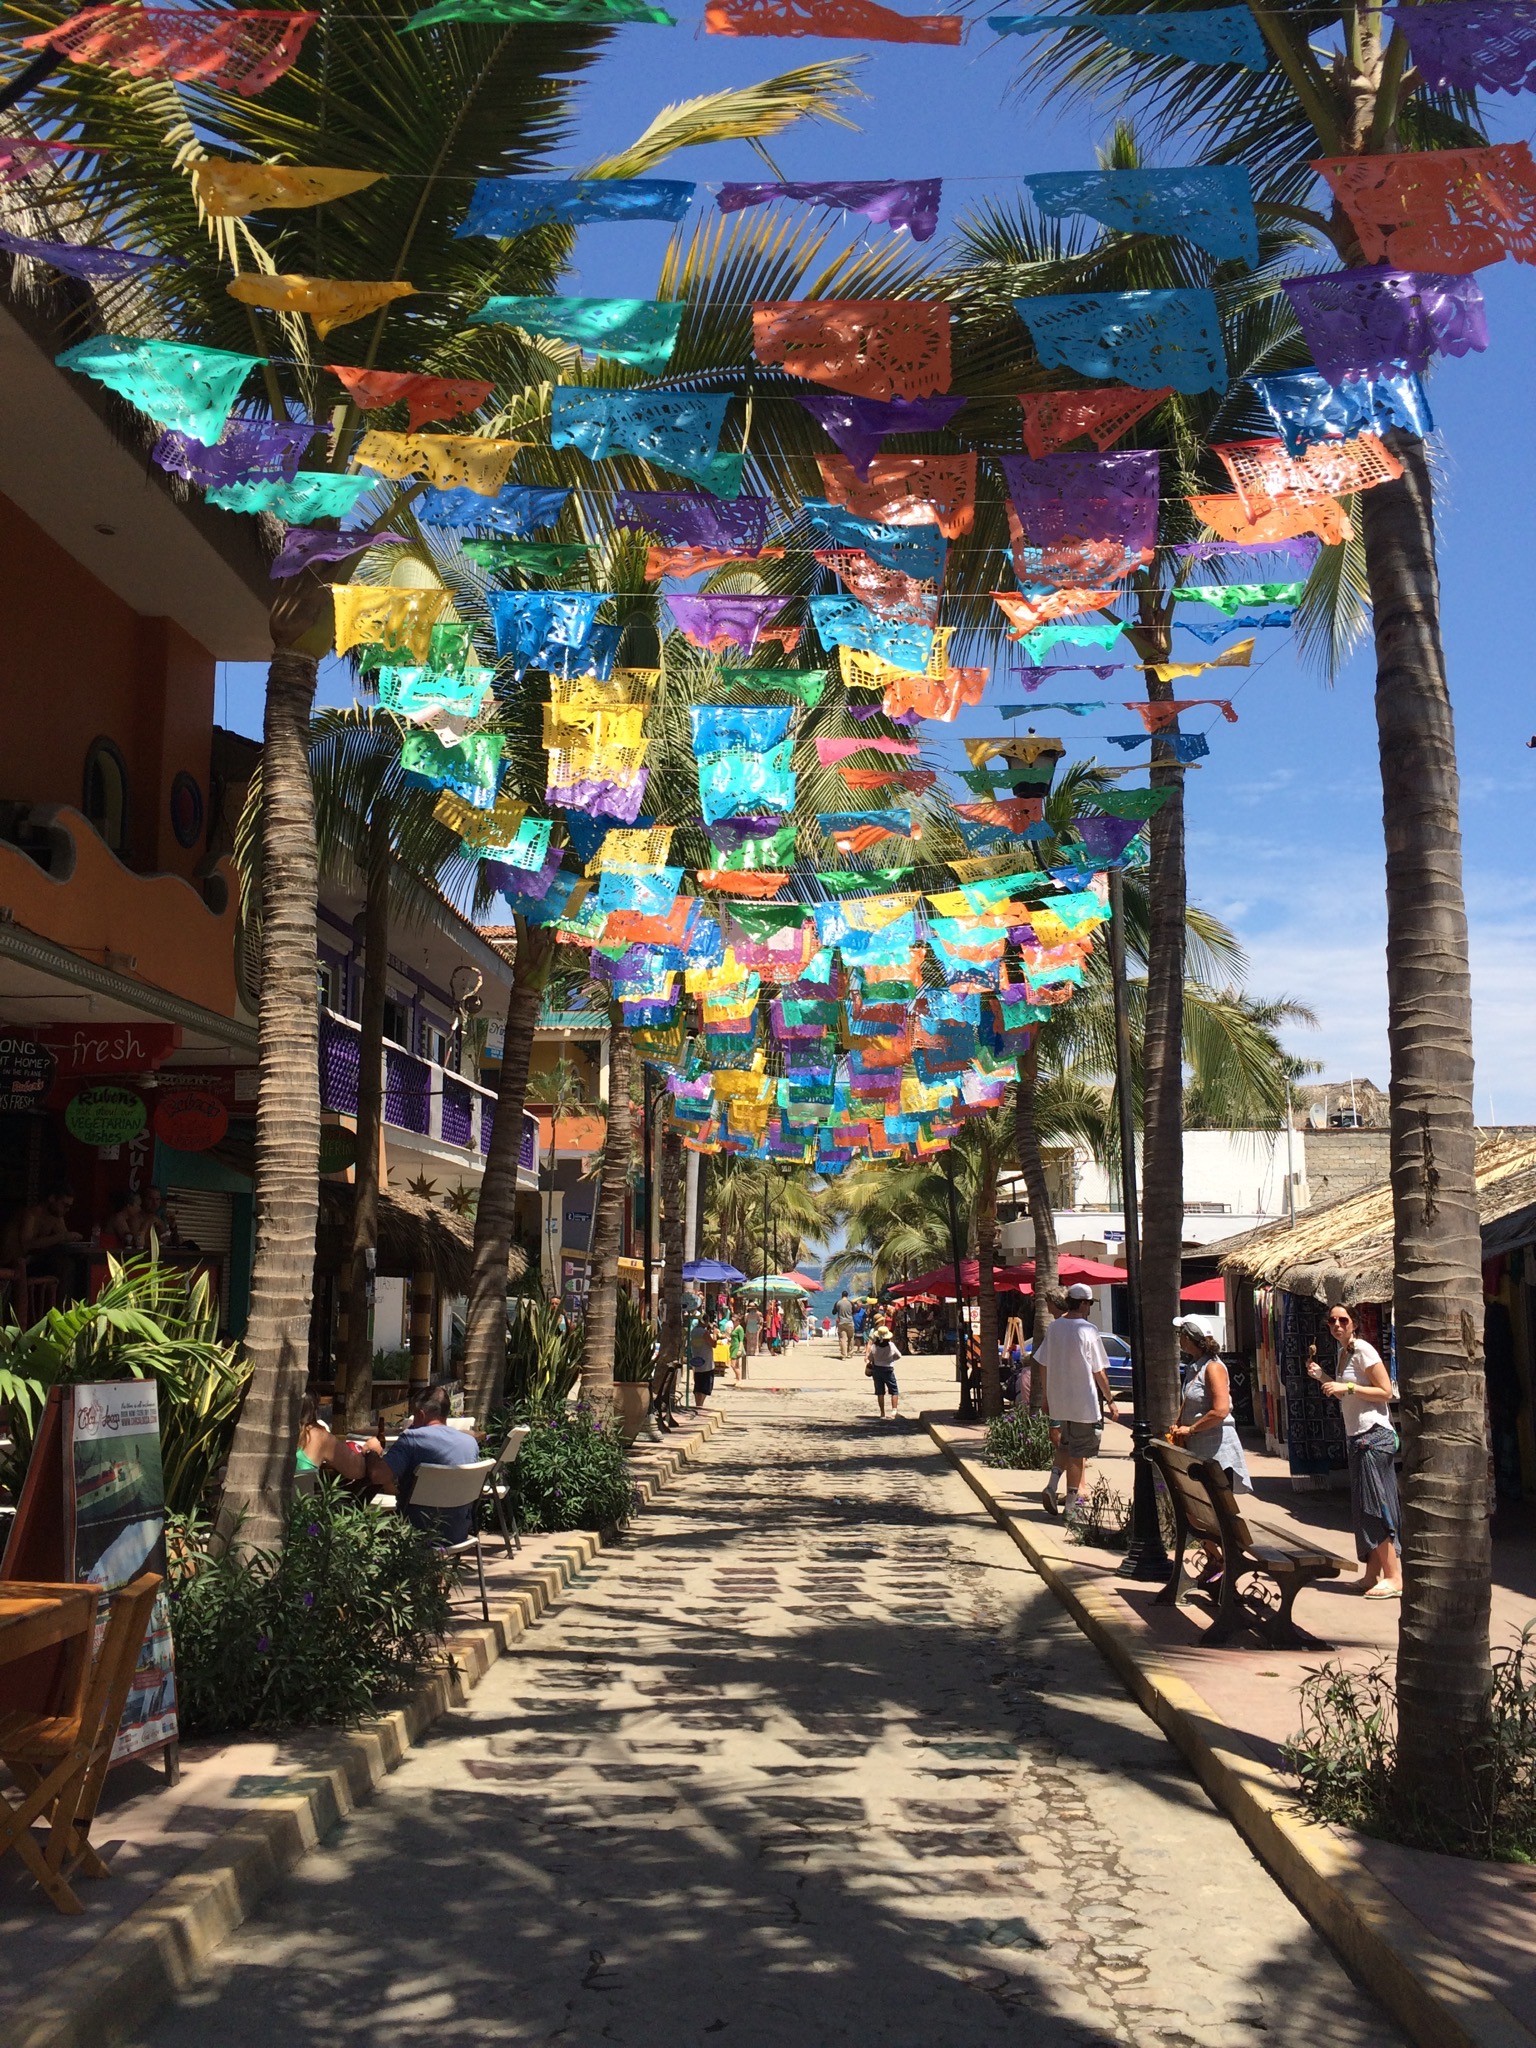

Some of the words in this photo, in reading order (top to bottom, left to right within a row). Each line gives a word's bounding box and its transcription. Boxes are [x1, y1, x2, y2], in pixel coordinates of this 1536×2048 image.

[72, 1030, 146, 1068] fresh
[15, 1057, 50, 1069] HOME?
[9, 1095, 35, 1110] FRESH
[71, 1116, 141, 1131] VEGETARIAN
[84, 1128, 122, 1144] dishes
